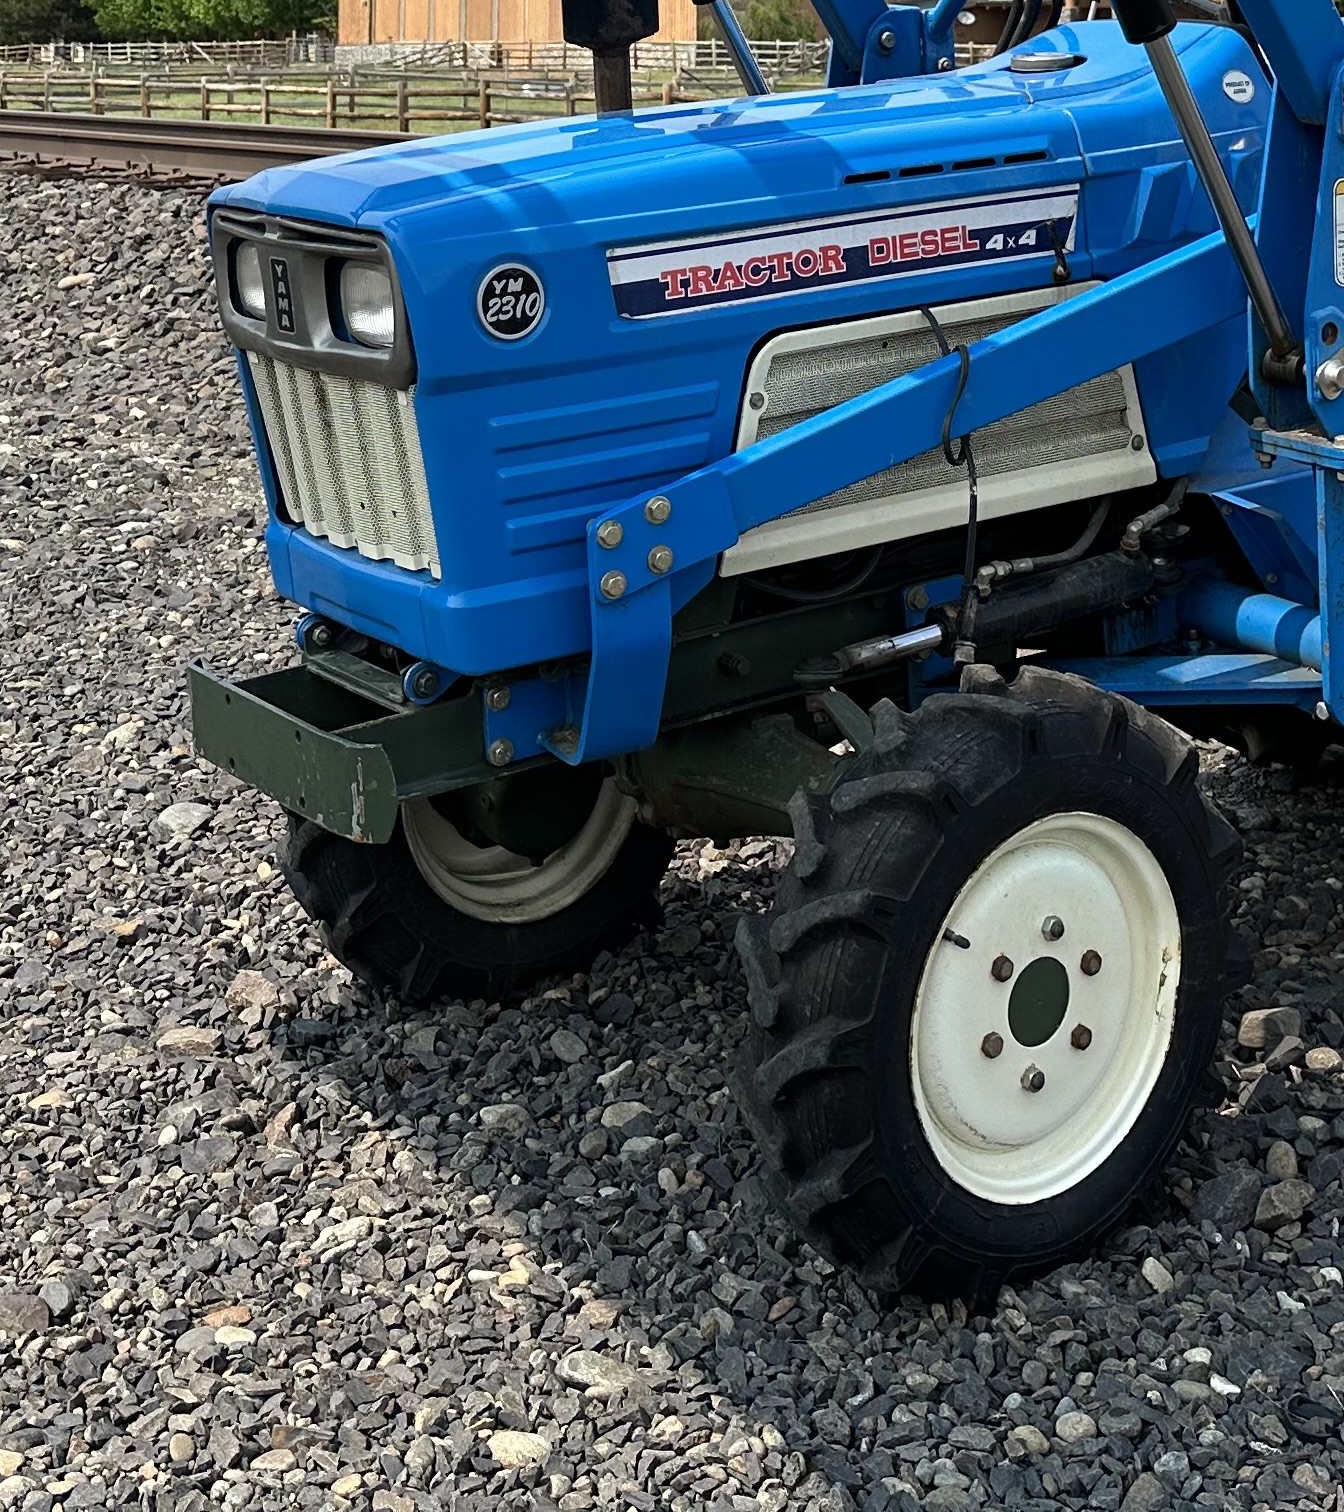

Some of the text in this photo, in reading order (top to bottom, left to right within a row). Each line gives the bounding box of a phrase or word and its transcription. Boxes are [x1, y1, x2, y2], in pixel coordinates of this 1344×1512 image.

[659, 244, 846, 300] TRACTOR
[868, 225, 981, 267] DIESEL
[492, 277, 524, 295] YM
[486, 292, 540, 323] 2310
